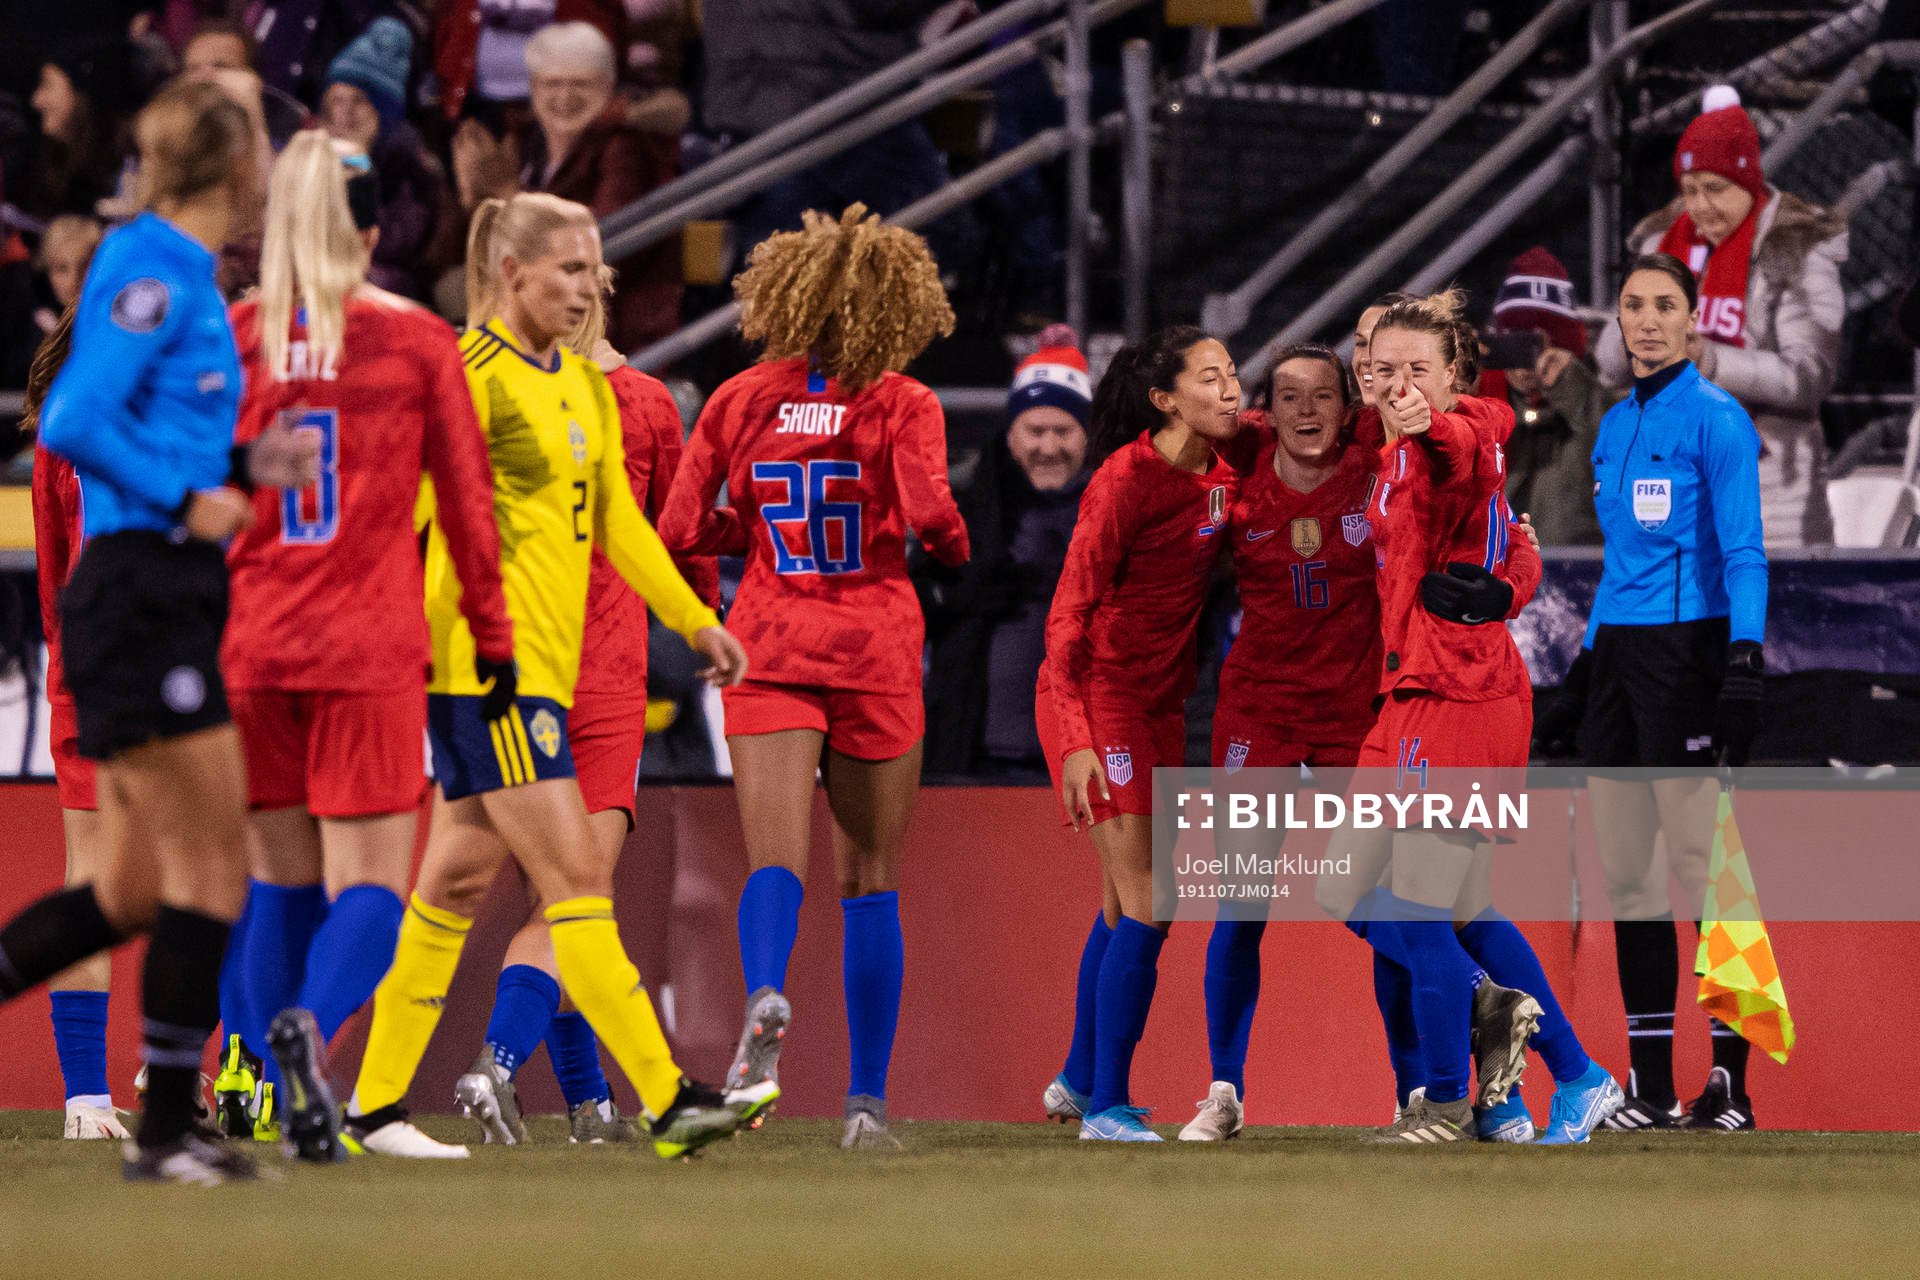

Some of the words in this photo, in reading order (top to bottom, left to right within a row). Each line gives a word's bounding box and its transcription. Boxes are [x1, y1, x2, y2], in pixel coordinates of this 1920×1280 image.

[1696, 295, 1747, 339] US
[776, 402, 847, 435] SHORT
[1637, 484, 1666, 496] FIFA
[572, 480, 587, 541] 2
[752, 459, 864, 576] 26
[1343, 515, 1364, 529] USA
[1289, 560, 1329, 609] 16
[1108, 754, 1131, 768] USA
[1229, 742, 1247, 758] USA
[1396, 736, 1428, 790] 14
